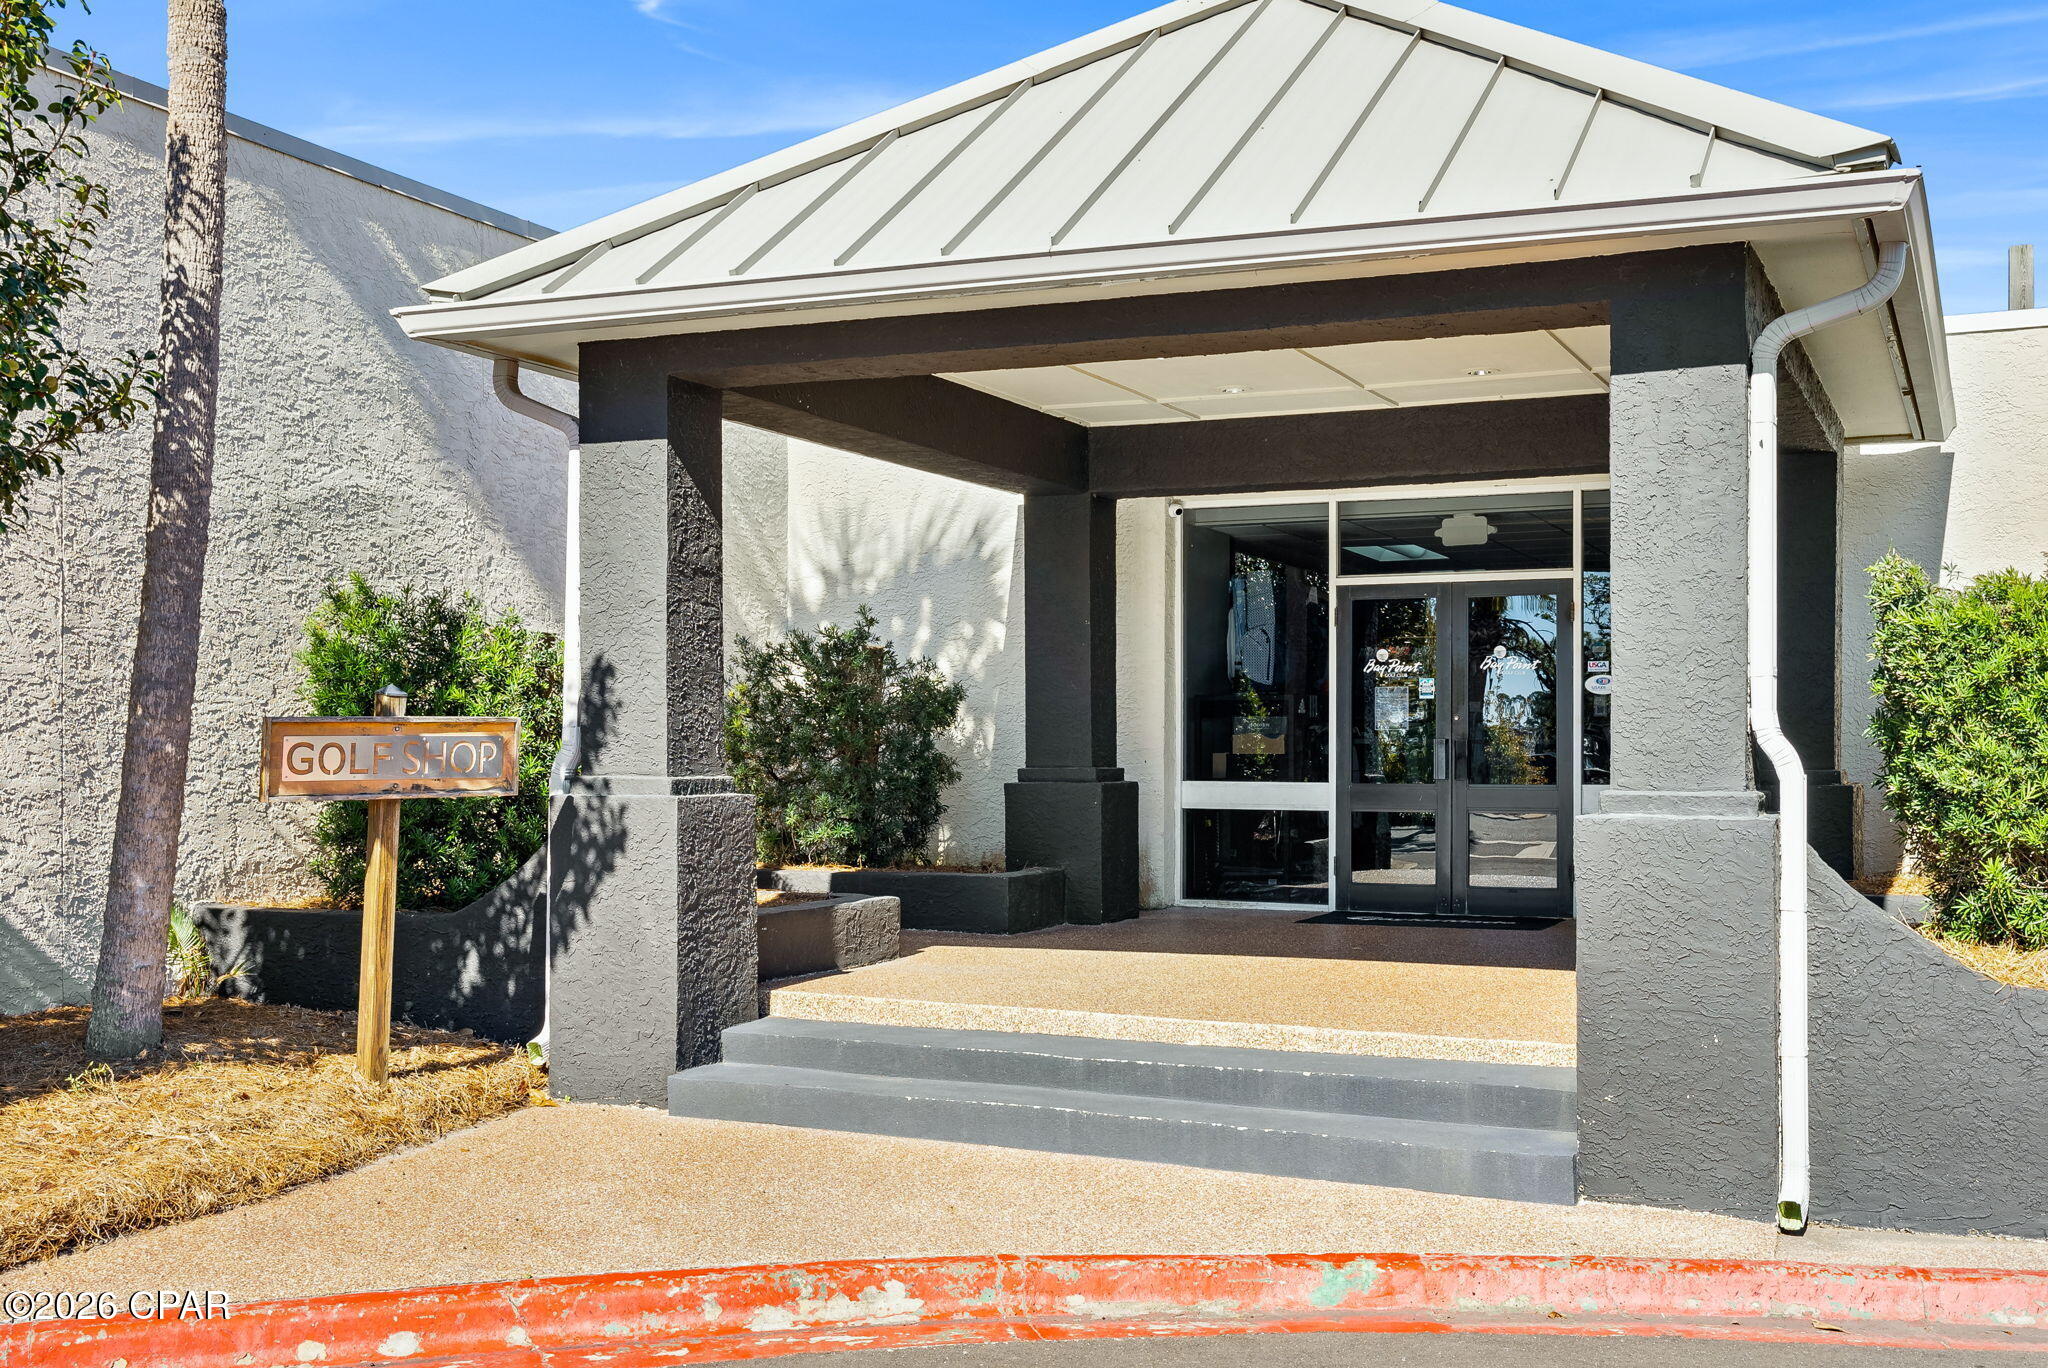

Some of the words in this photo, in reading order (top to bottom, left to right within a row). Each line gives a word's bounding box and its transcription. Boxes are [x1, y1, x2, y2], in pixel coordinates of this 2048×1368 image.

[1363, 659, 1388, 677] Bay
[1387, 659, 1422, 673] Point
[1480, 656, 1505, 674] Bay
[1505, 656, 1541, 669] Point
[286, 741, 393, 776] GOLF
[402, 740, 498, 775] SHOP
